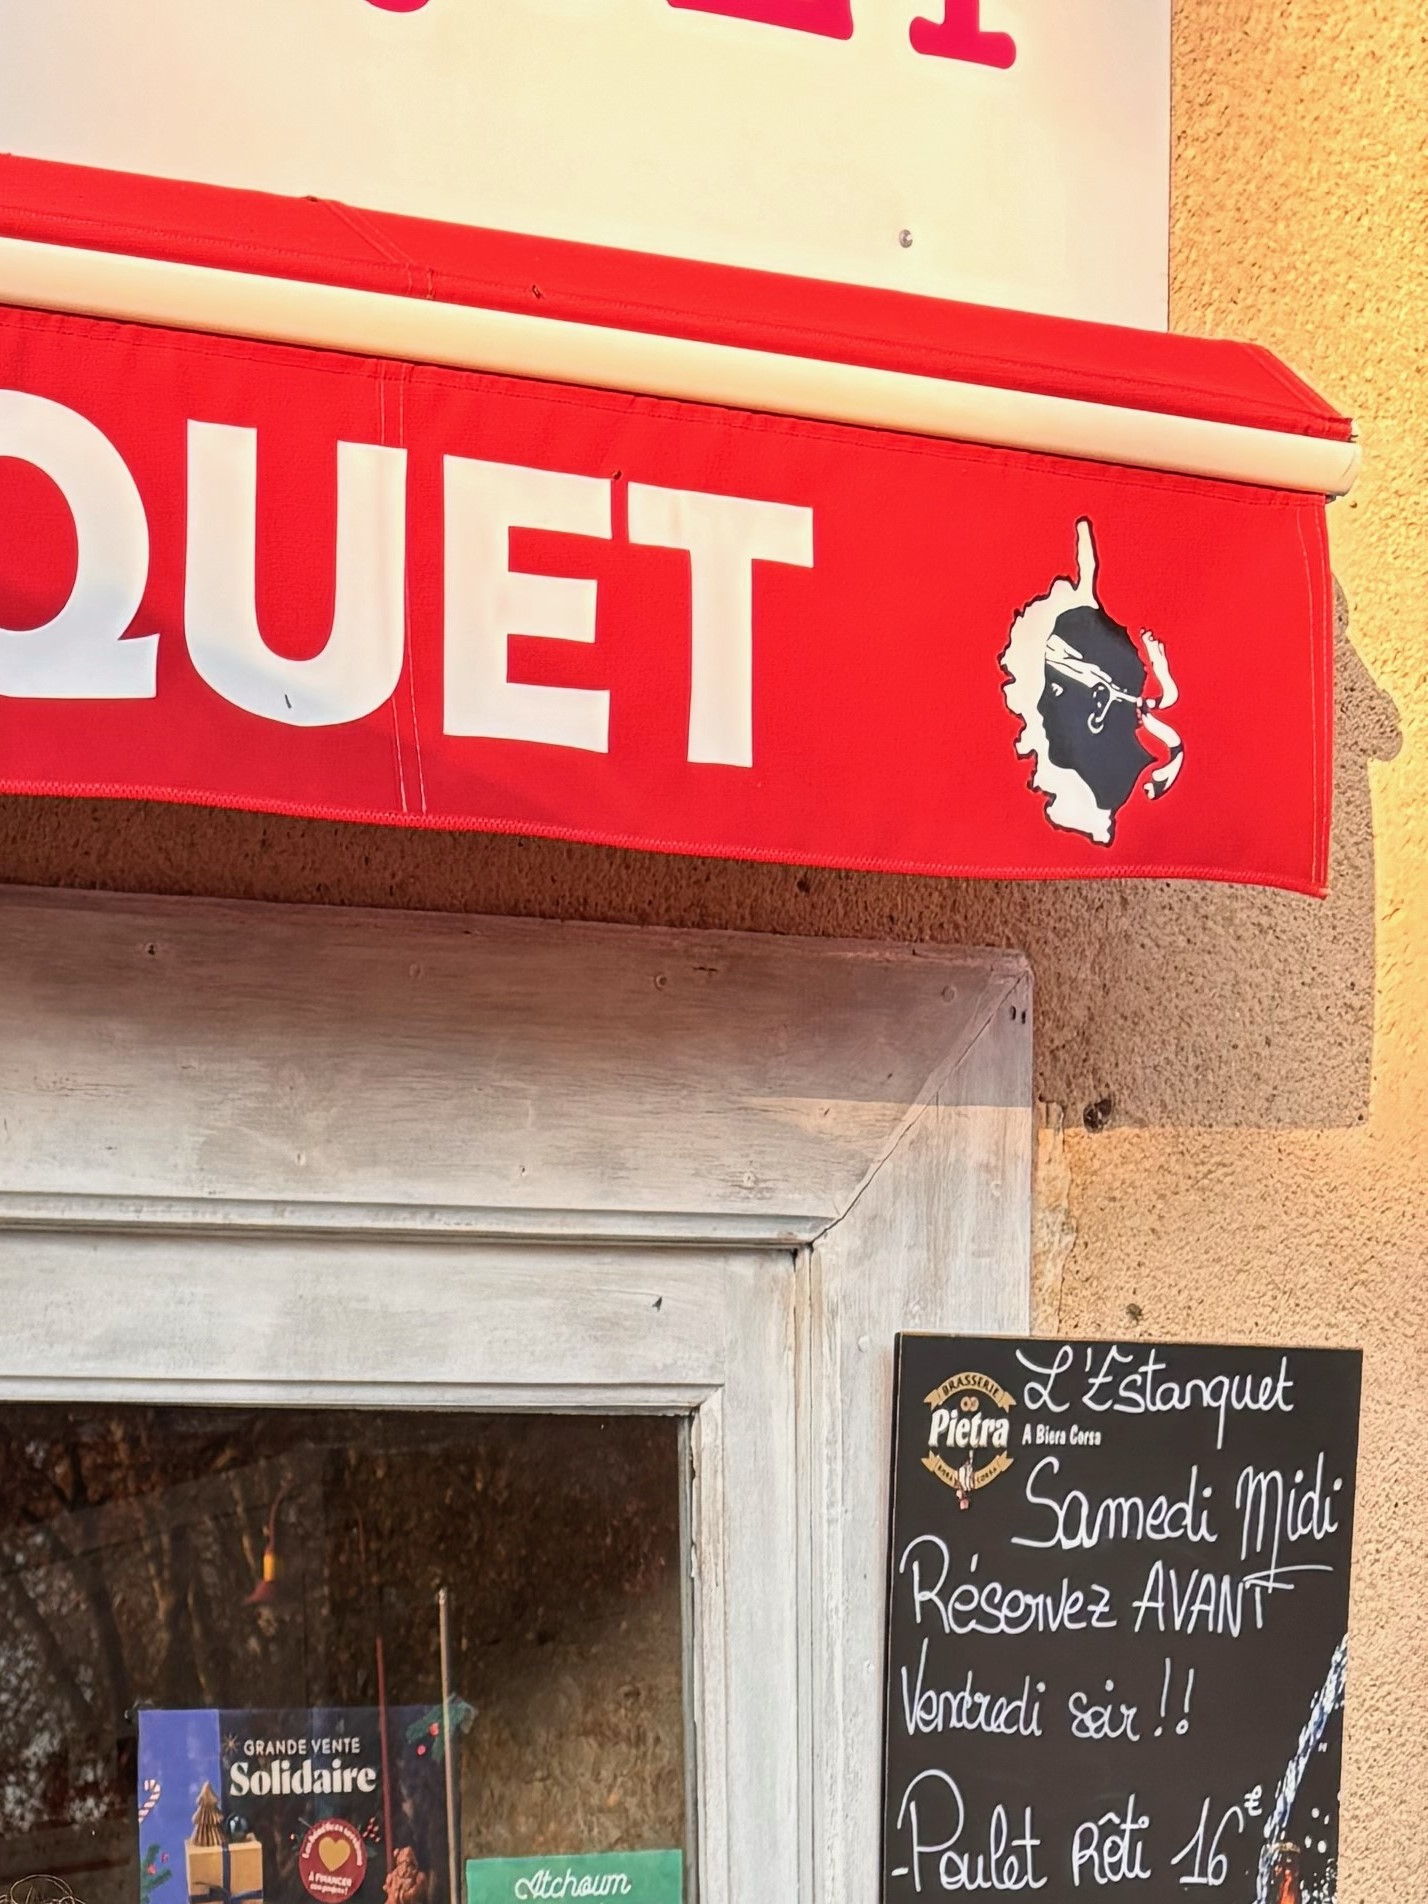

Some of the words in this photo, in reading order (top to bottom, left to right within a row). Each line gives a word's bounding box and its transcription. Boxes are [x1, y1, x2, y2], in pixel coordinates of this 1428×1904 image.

[928, 1408, 1010, 1448] Pietra
[1016, 1346, 1294, 1450] L'Estanquet
[1021, 1424, 1032, 1446] A
[1036, 1424, 1066, 1446] Biera
[1069, 1424, 1102, 1446] Corsa
[1011, 1457, 1218, 1549] Samedi
[1236, 1453, 1343, 1592] Midi
[899, 1535, 1118, 1635] Réservez
[1133, 1558, 1333, 1638] AVANT
[901, 1637, 1046, 1736] Vendredi
[229, 1757, 377, 1797] Solidaire
[243, 1738, 307, 1757] GRANDE
[310, 1736, 361, 1755] VENTE
[1071, 1793, 1152, 1887] Rôti
[514, 1868, 632, 1900] Atchoum
